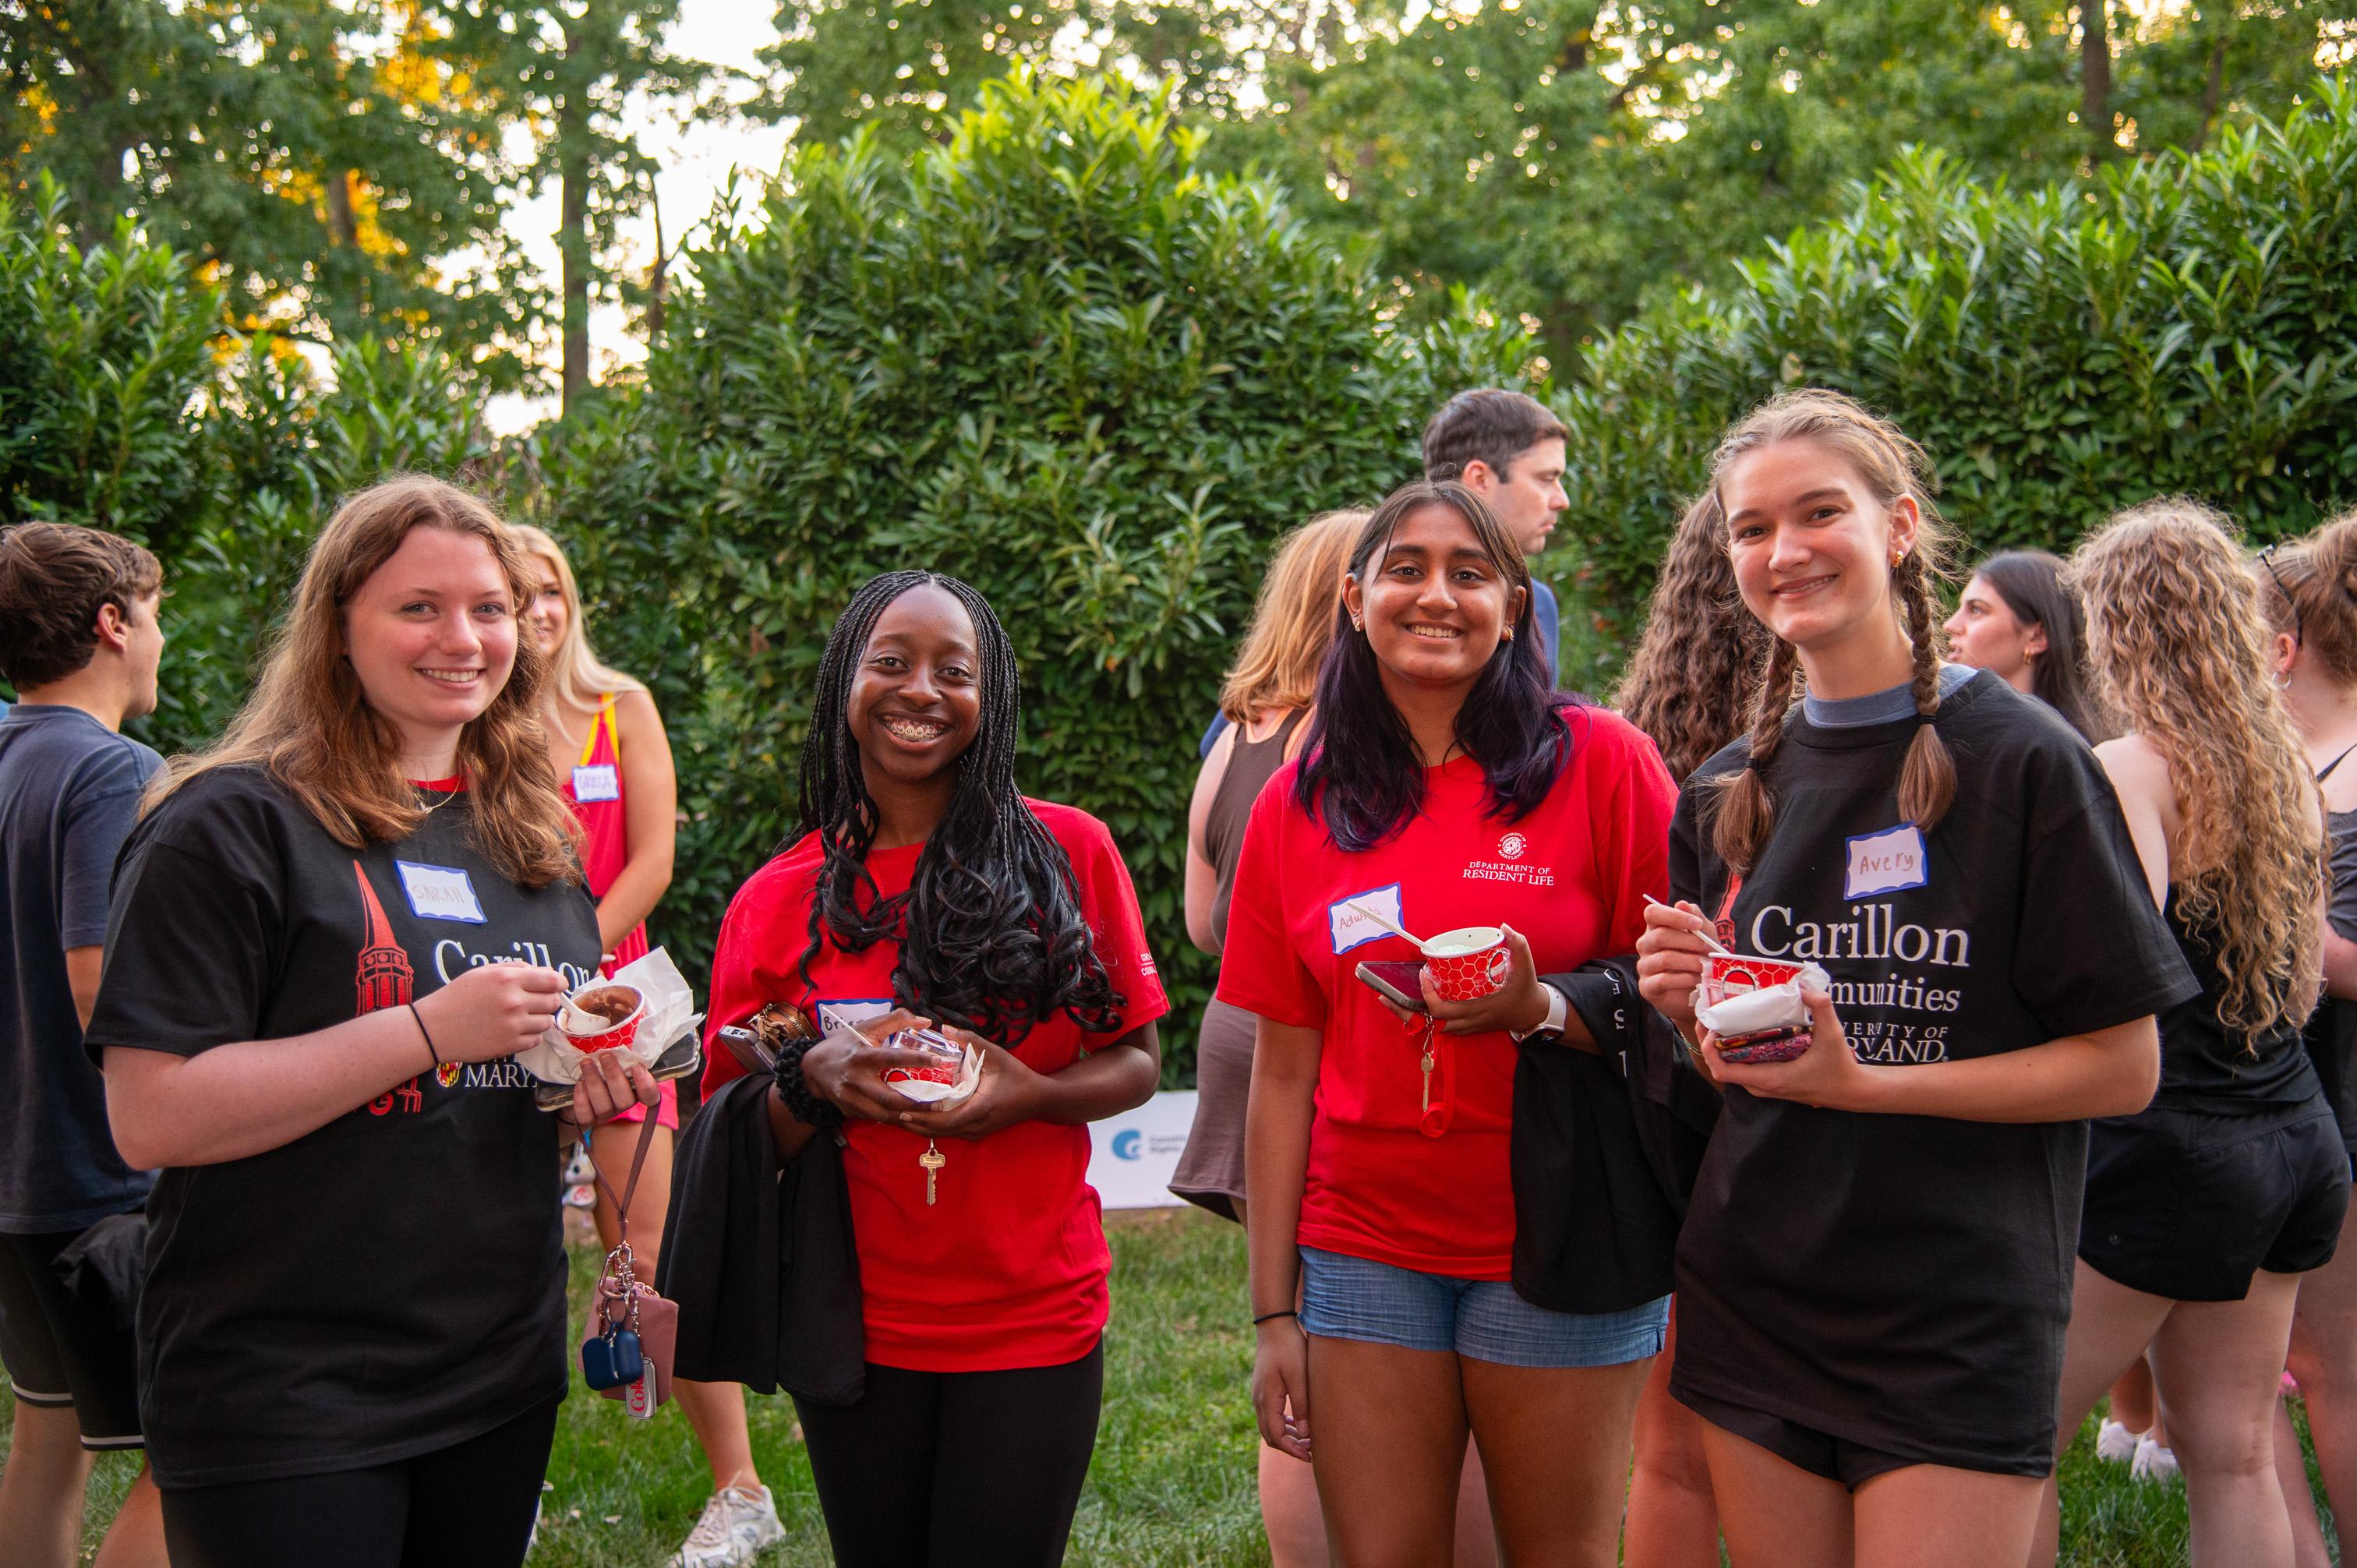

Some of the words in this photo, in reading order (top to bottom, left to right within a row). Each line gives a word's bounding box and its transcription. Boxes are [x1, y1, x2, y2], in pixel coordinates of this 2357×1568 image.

[1498, 849, 1524, 860] MARYLAND
[1860, 853, 1914, 874] Avery
[1469, 861, 1535, 874] DEPARTMENT
[1462, 869, 1525, 882] RESIDENT
[1528, 874, 1554, 886] LIFE
[1751, 904, 1970, 967] Carillon
[1828, 973, 1961, 1012] munities
[1924, 1026, 1949, 1039] OF
[630, 1374, 645, 1412] Cok
